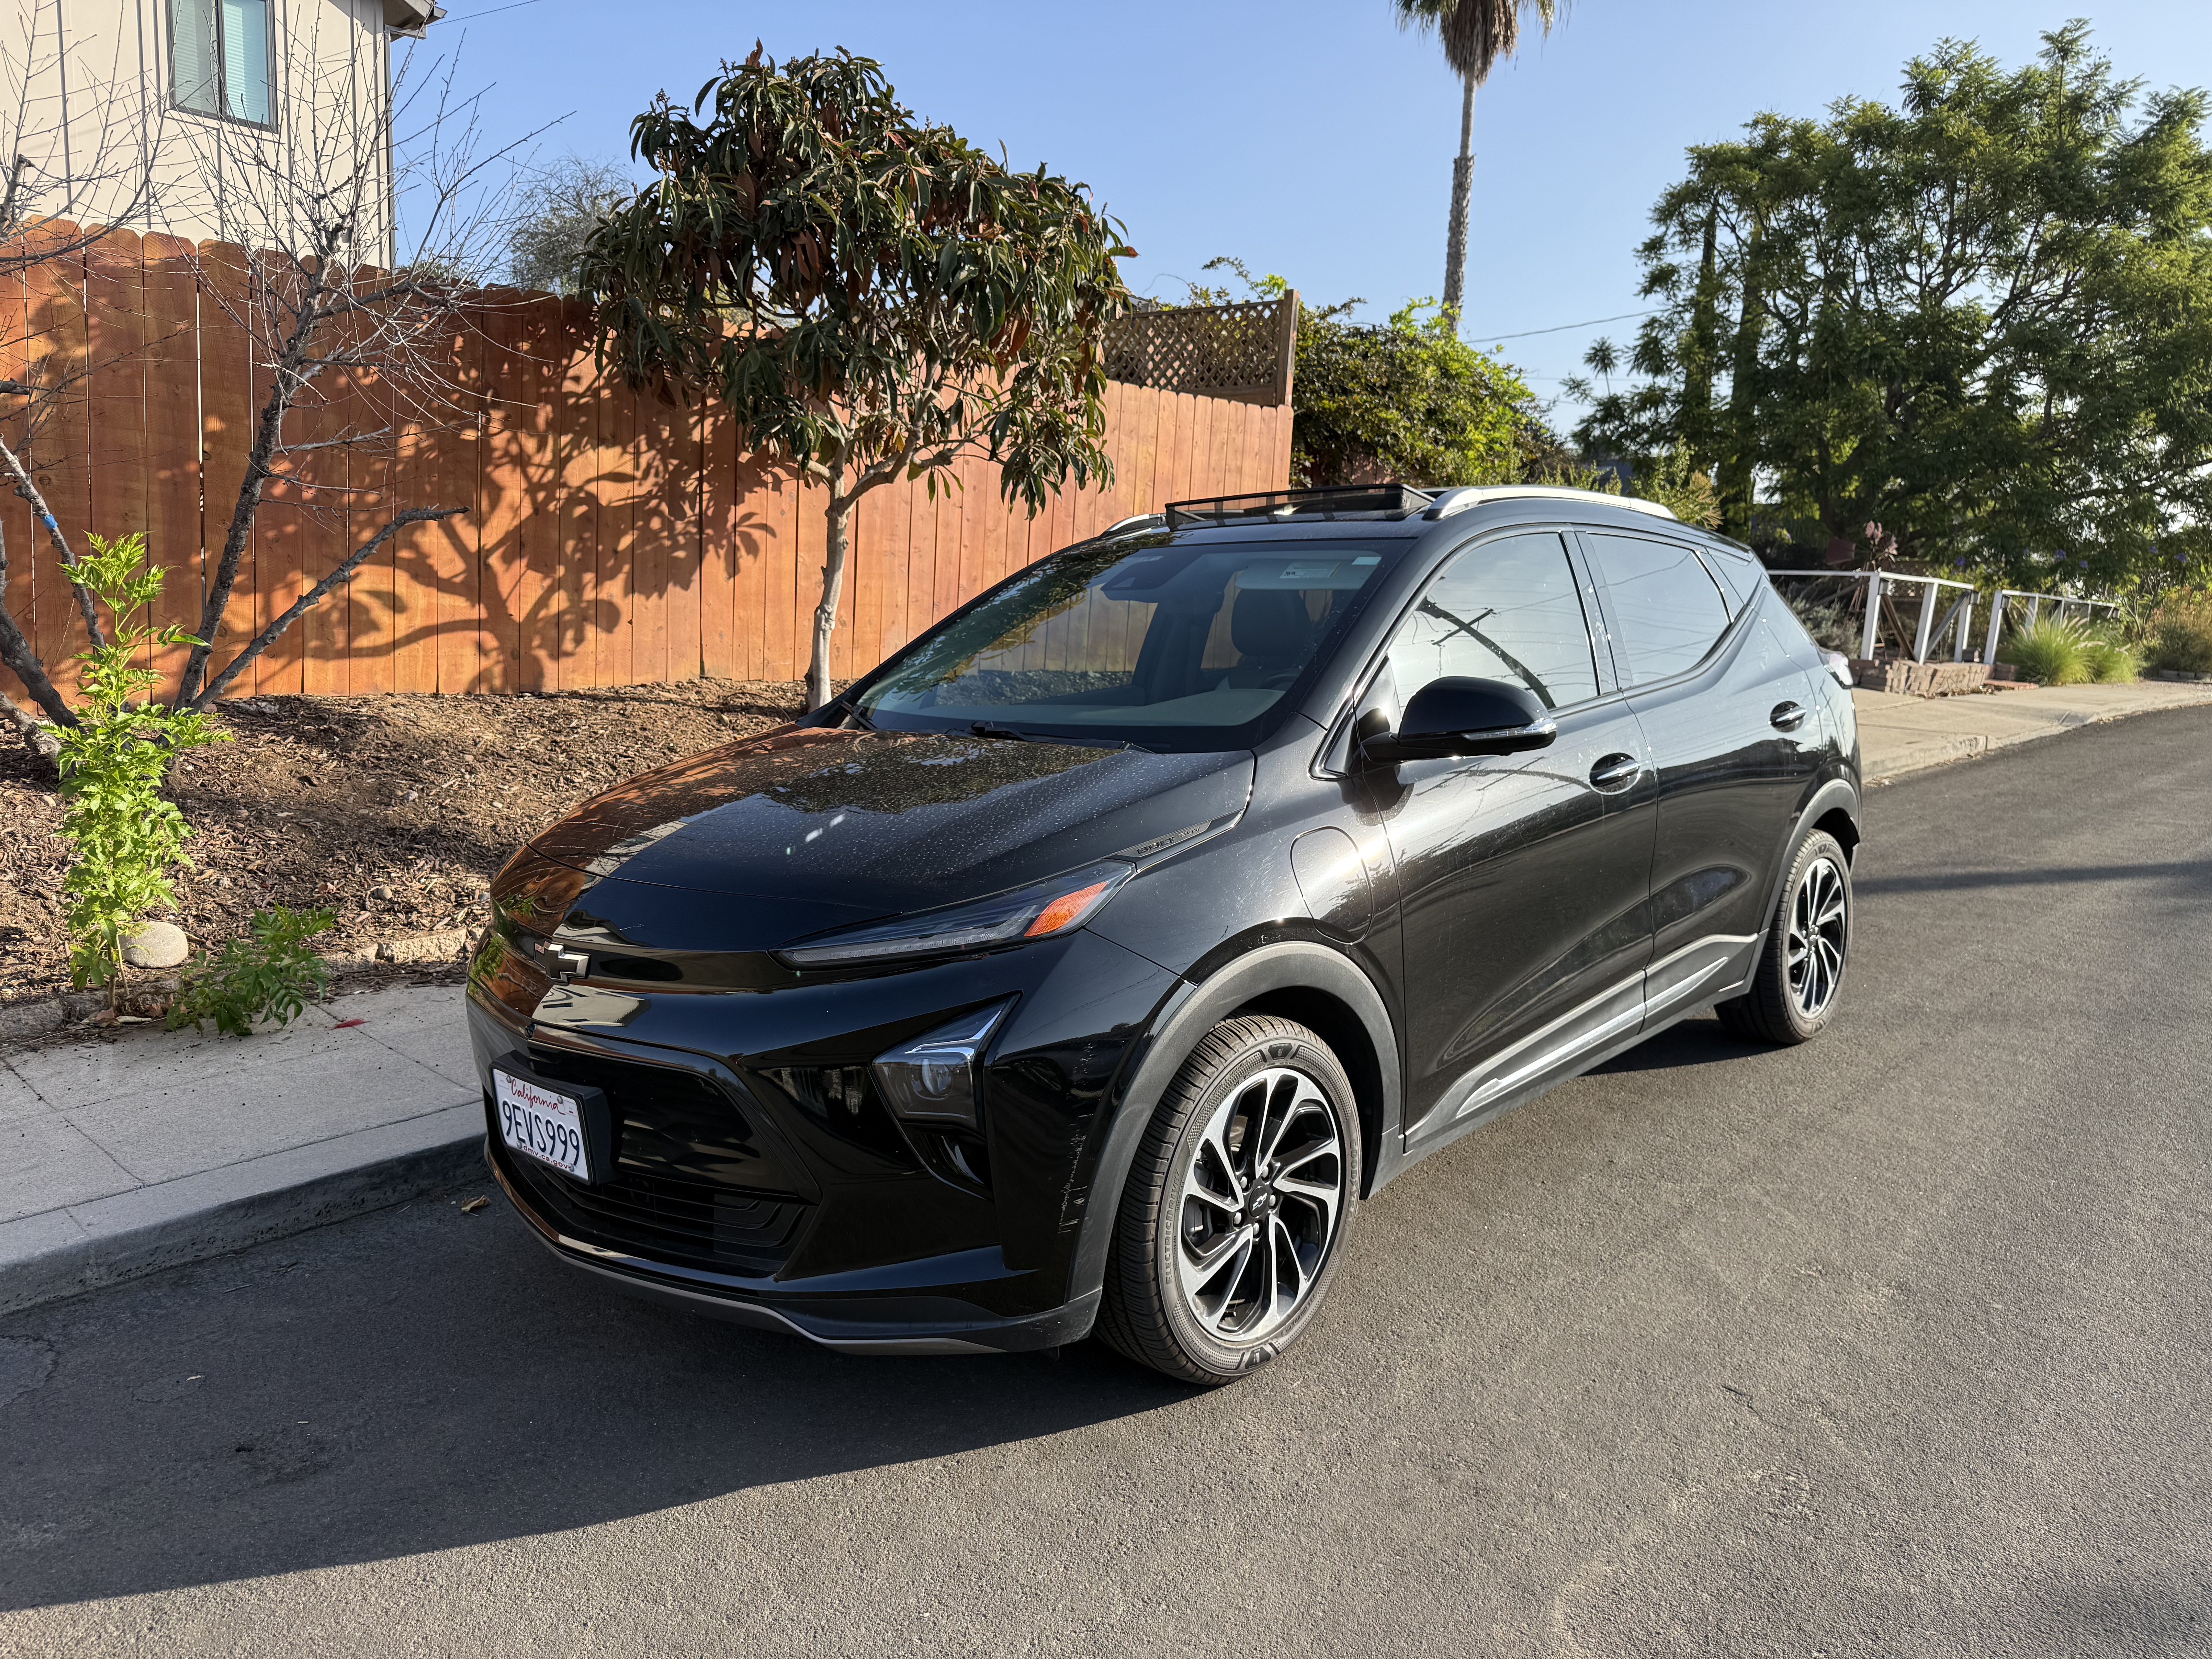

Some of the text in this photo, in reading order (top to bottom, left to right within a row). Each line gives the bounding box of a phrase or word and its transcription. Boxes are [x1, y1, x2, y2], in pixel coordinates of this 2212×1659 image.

[1178, 827, 1200, 838] EUV
[511, 1079, 566, 1115] California
[503, 1101, 580, 1166] 9EVS999
[524, 1146, 568, 1169] dmv.ca.gov
[1345, 1140, 1357, 1230] GOODYEAR
